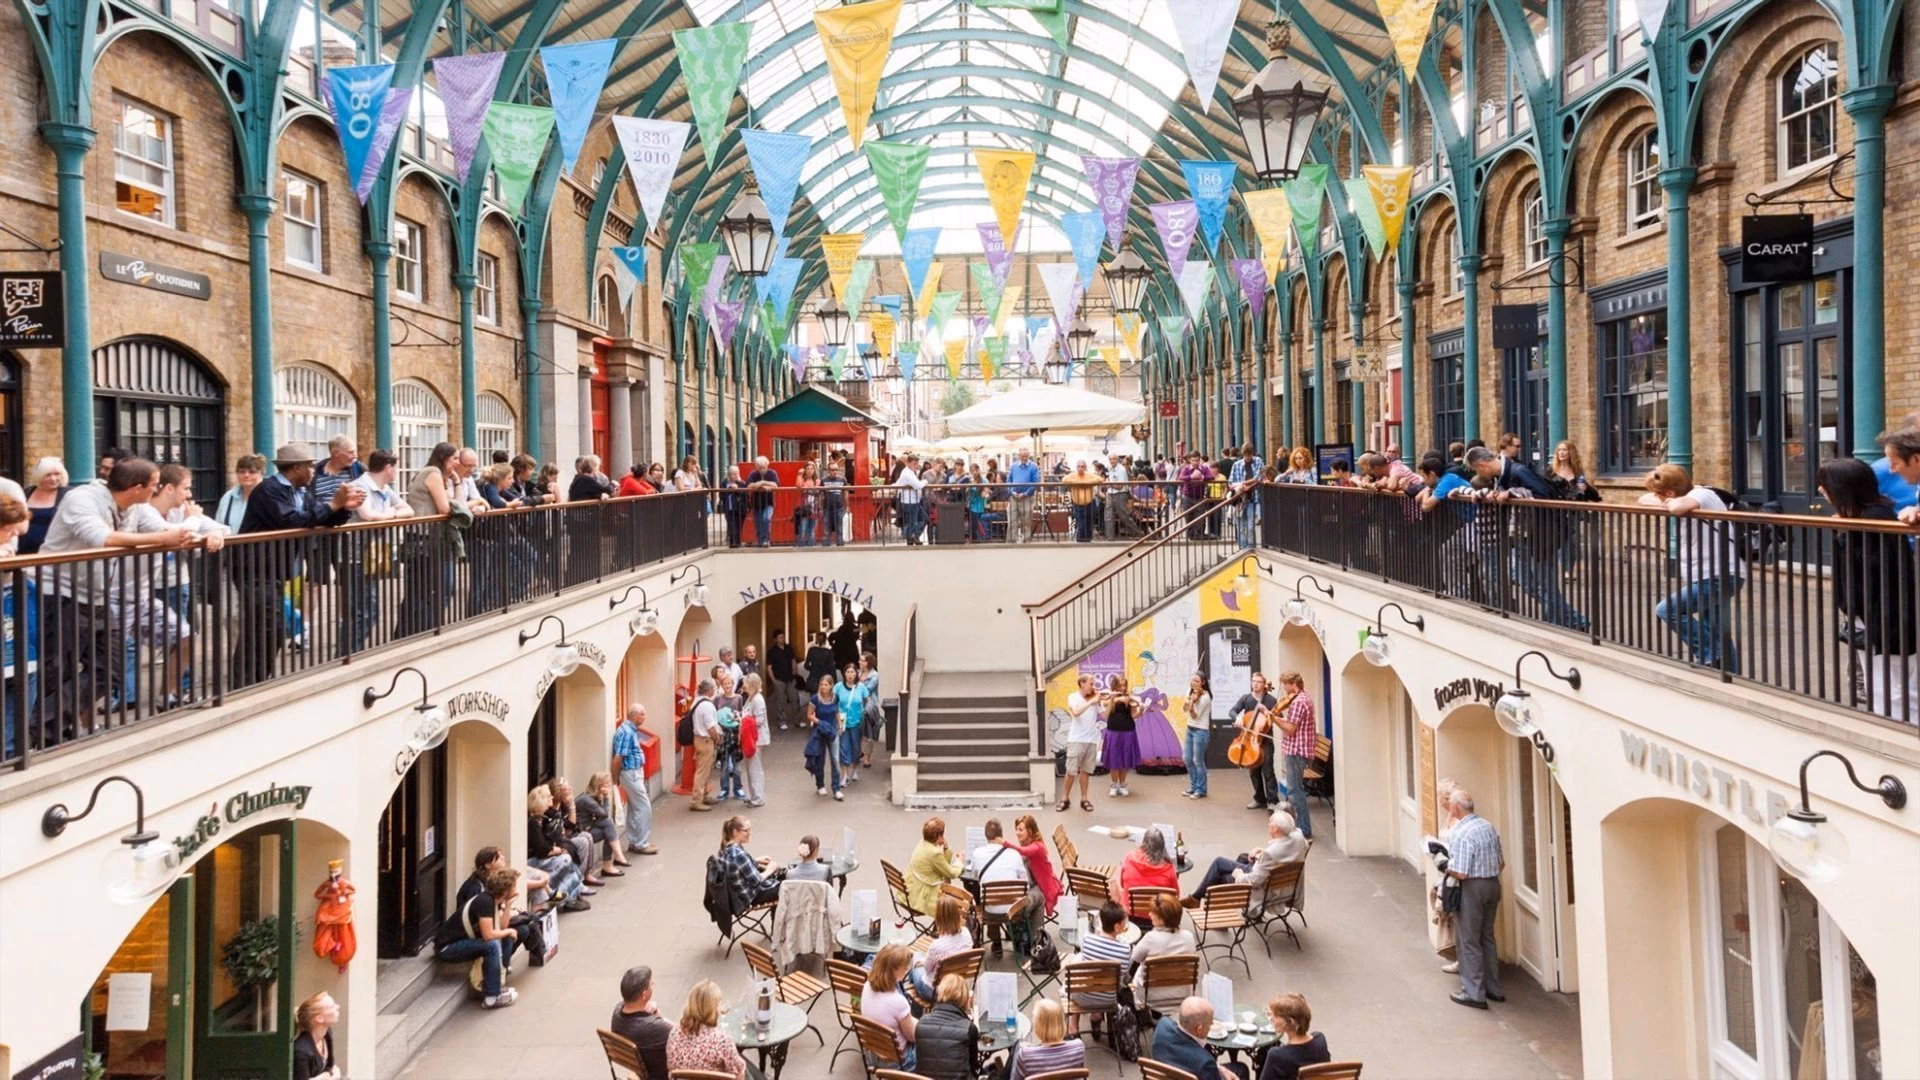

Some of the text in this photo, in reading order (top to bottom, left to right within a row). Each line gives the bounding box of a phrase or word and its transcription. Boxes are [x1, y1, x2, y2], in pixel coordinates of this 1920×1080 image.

[349, 76, 371, 139] 180
[633, 131, 670, 145] 1830
[633, 151, 671, 165] 2010
[1197, 173, 1222, 185] 180
[1381, 171, 1399, 217] 180
[1168, 208, 1186, 248] 180
[988, 242, 1005, 253] 201
[1747, 242, 1801, 255] CARAT
[116, 264, 127, 275] LE
[155, 272, 201, 291] QUOTIDIEN
[5, 315, 43, 333] Pain
[739, 575, 874, 609] NAUTICALIA
[1233, 646, 1249, 655] 180
[448, 690, 510, 721] WORKSHOP
[1434, 677, 1472, 711] frozen
[1533, 729, 1554, 763] co
[1619, 729, 1792, 830] WHISTLE
[225, 781, 313, 824] Chutney
